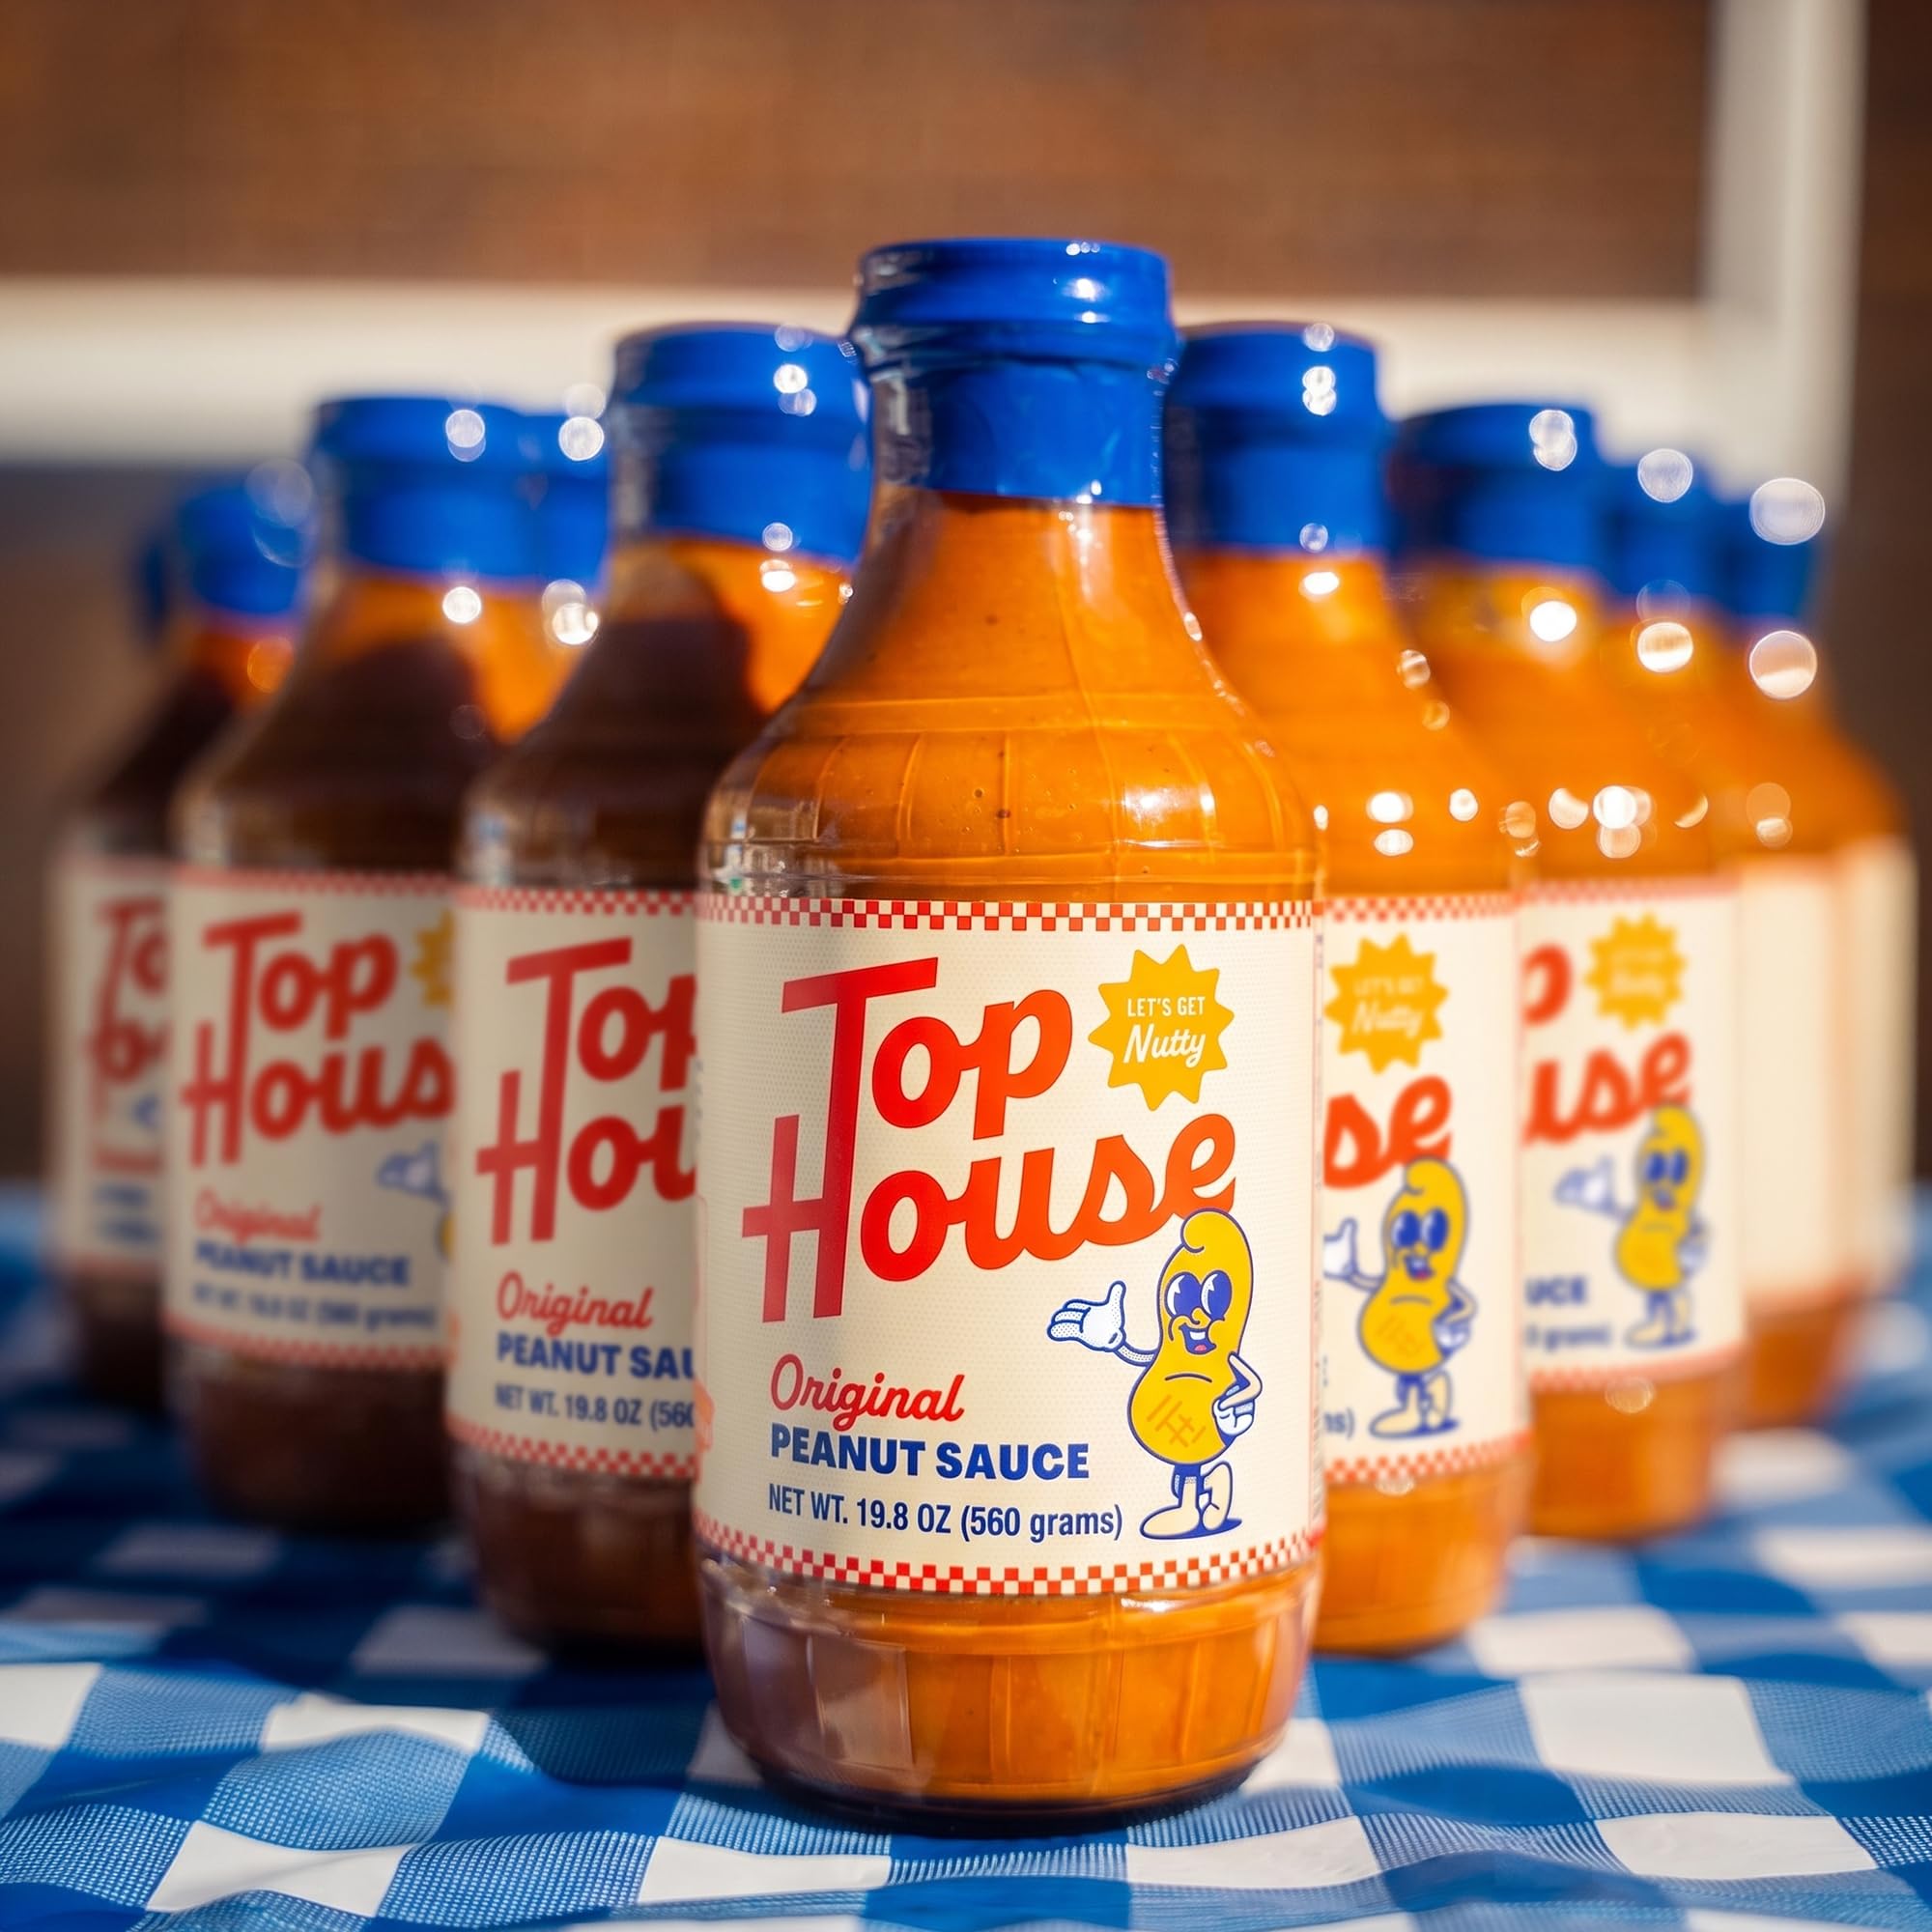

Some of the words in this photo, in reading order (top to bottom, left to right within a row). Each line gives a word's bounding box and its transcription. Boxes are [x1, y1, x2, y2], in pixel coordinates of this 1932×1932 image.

[203, 910, 399, 1041] Top
[1126, 997, 1172, 1017] LET'S
[1177, 996, 1206, 1016] GET
[781, 956, 1072, 1141] Top
[1122, 1023, 1207, 1068] Nutty
[181, 1020, 454, 1170] Hous
[474, 1069, 696, 1246] Hou
[741, 1113, 1236, 1323] House
[497, 1269, 654, 1338] Original
[497, 1330, 622, 1377] PEANUT
[565, 1395, 608, 1422] 19.8
[613, 1399, 641, 1425] OZ
[771, 1353, 965, 1432] Original
[772, 1423, 925, 1476] PEANUT
[935, 1442, 1090, 1480] SAUCE
[769, 1483, 805, 1515] NET
[810, 1492, 848, 1523] WT.
[857, 1498, 908, 1530] 19.8
[918, 1503, 952, 1534] OZ
[961, 1505, 1020, 1542] (560
[1030, 1504, 1122, 1543] grams)
